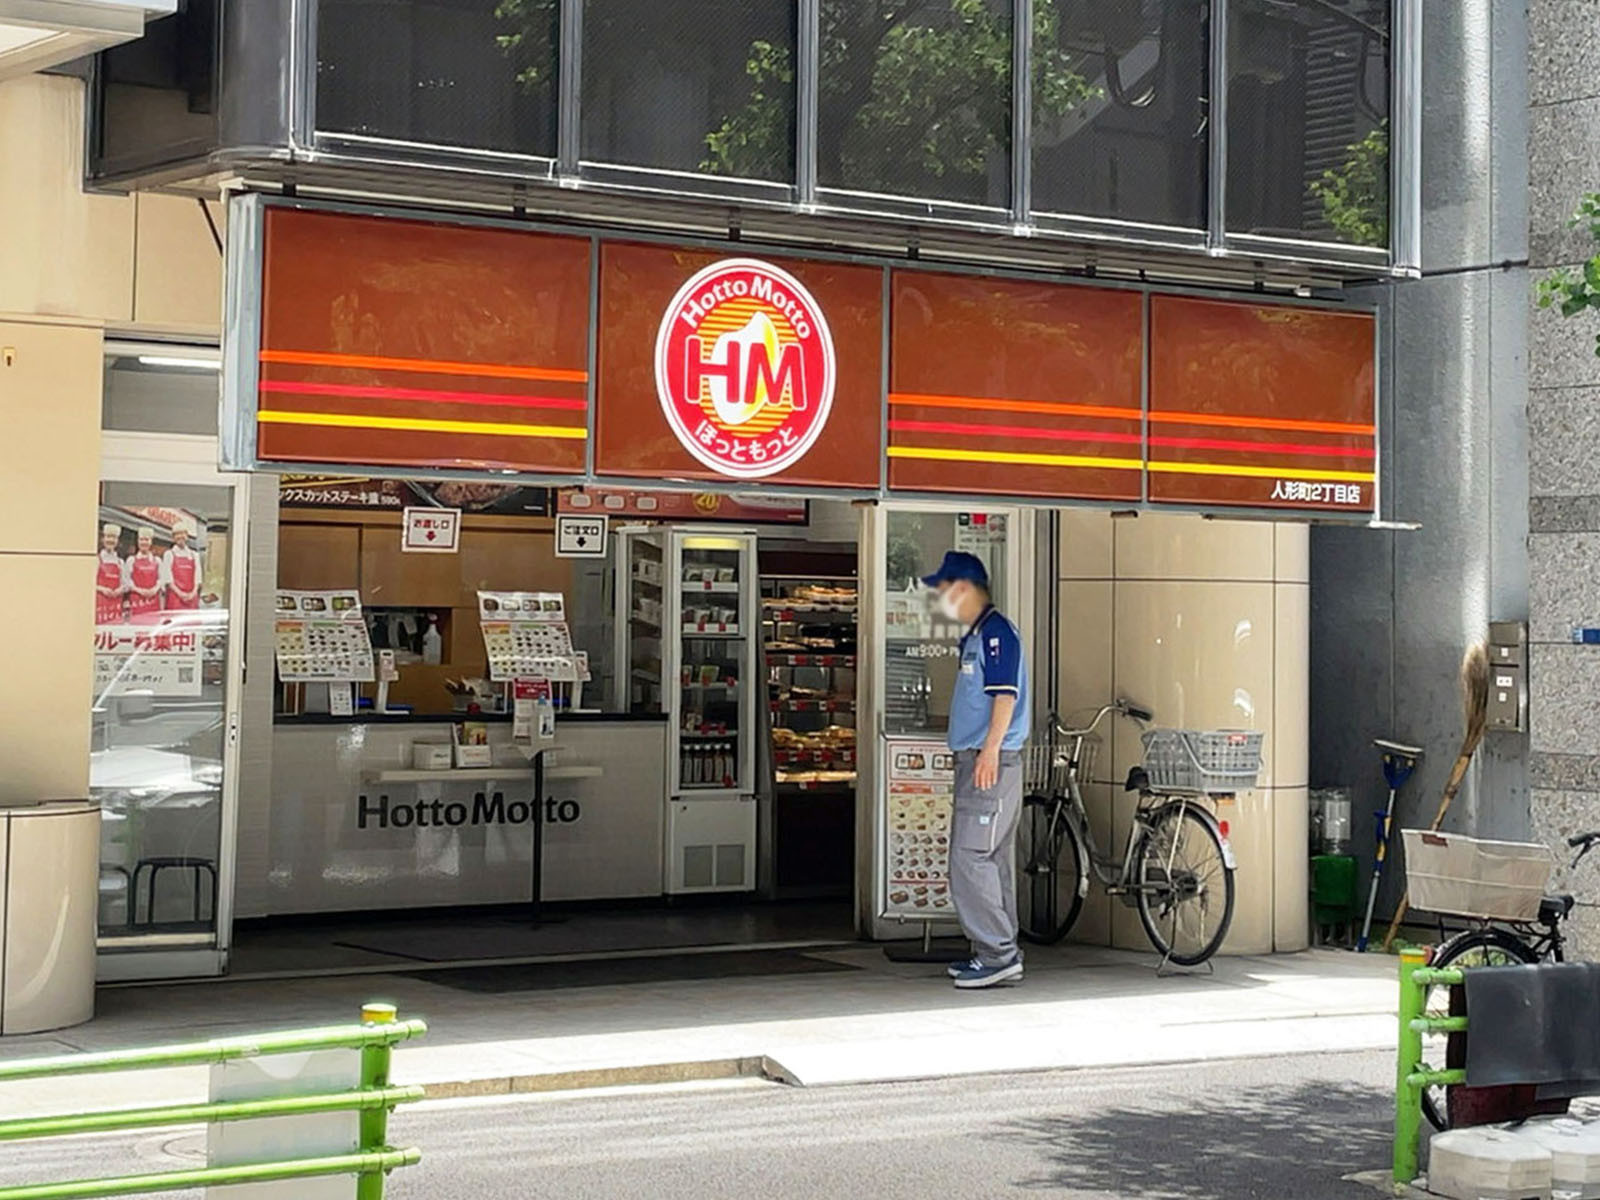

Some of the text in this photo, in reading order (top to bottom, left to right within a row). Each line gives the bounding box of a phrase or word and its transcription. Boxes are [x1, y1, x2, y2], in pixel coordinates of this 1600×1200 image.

[681, 275, 811, 339] Hotto Motto
[685, 334, 807, 411] HM
[695, 420, 799, 461] ほっともっと
[1271, 480, 1361, 503] 人形町2丁目店
[564, 525, 599, 536] ご注文口
[358, 795, 468, 829] Hotto
